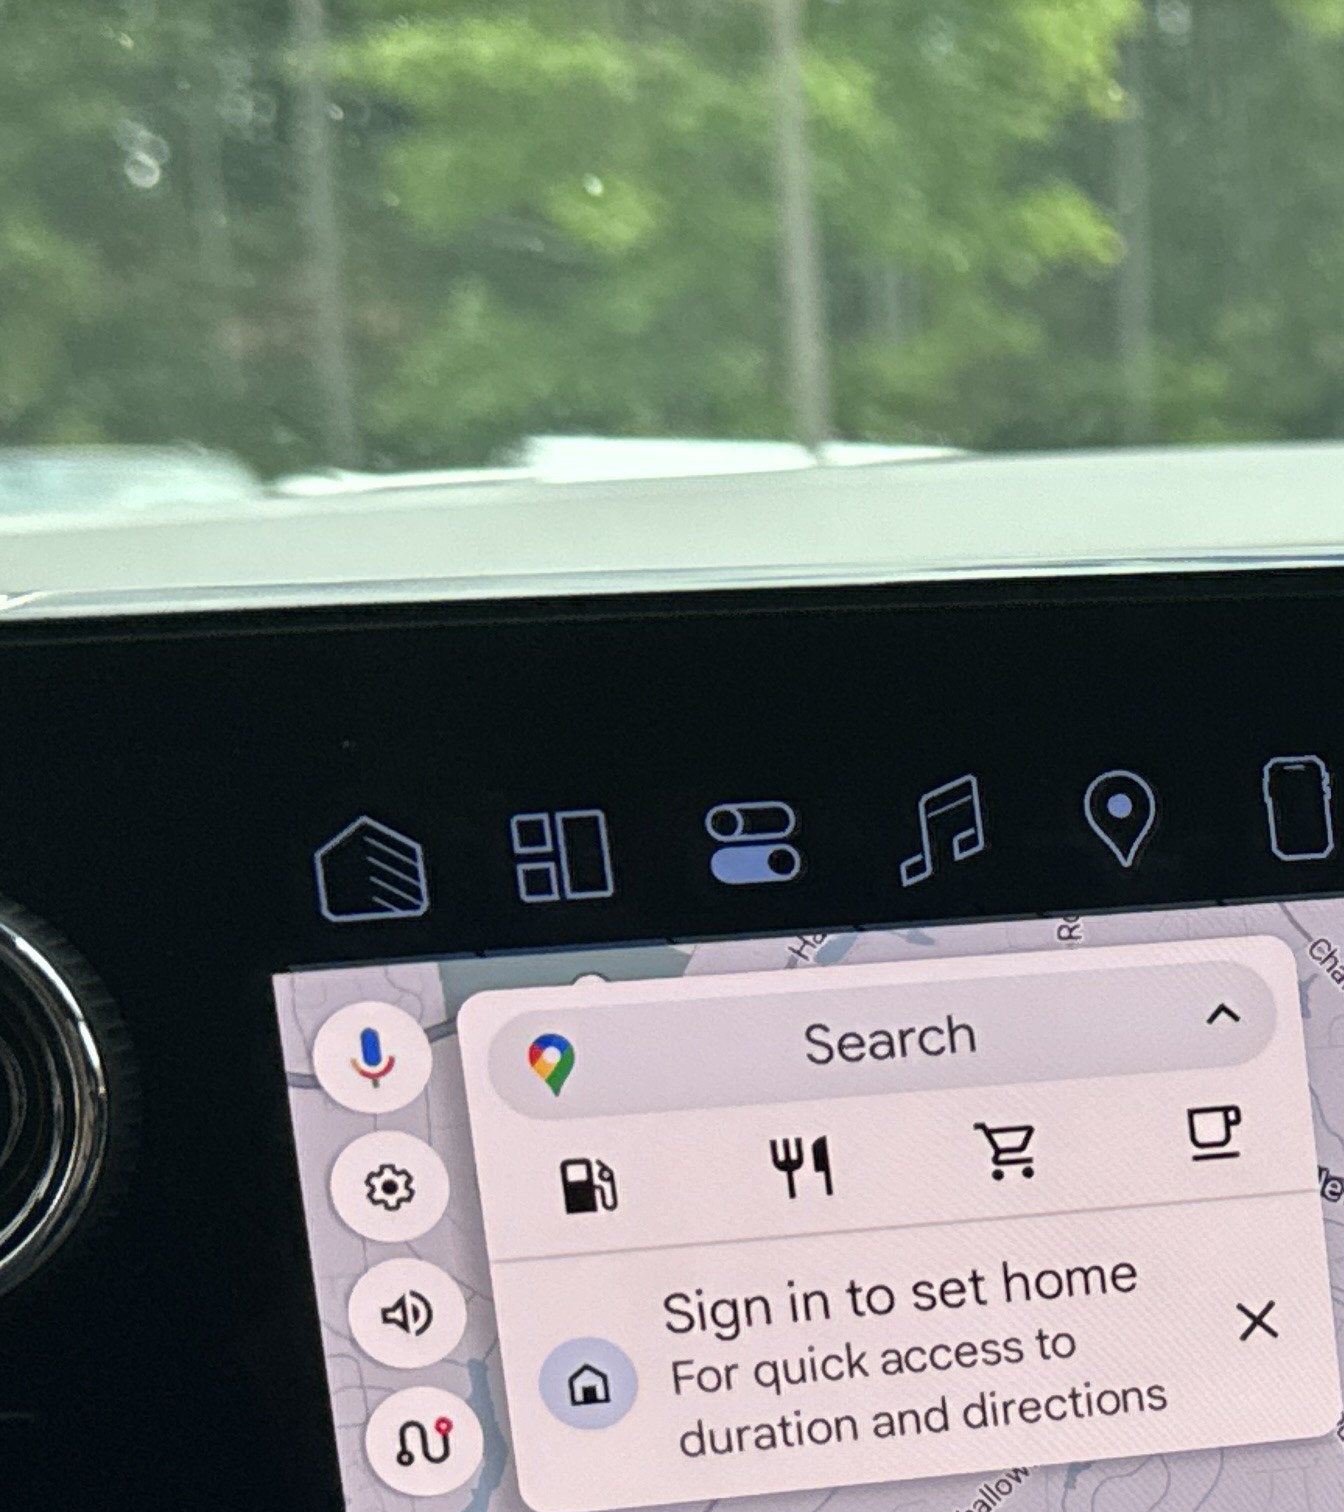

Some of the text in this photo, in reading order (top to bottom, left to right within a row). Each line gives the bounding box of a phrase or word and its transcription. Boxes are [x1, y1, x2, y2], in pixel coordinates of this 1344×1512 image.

[805, 1015, 977, 1065] Search
[664, 1261, 1138, 1340] Sign in to set home
[672, 1328, 1076, 1396] For quick access to
[680, 1379, 1168, 1458] duration and directions
